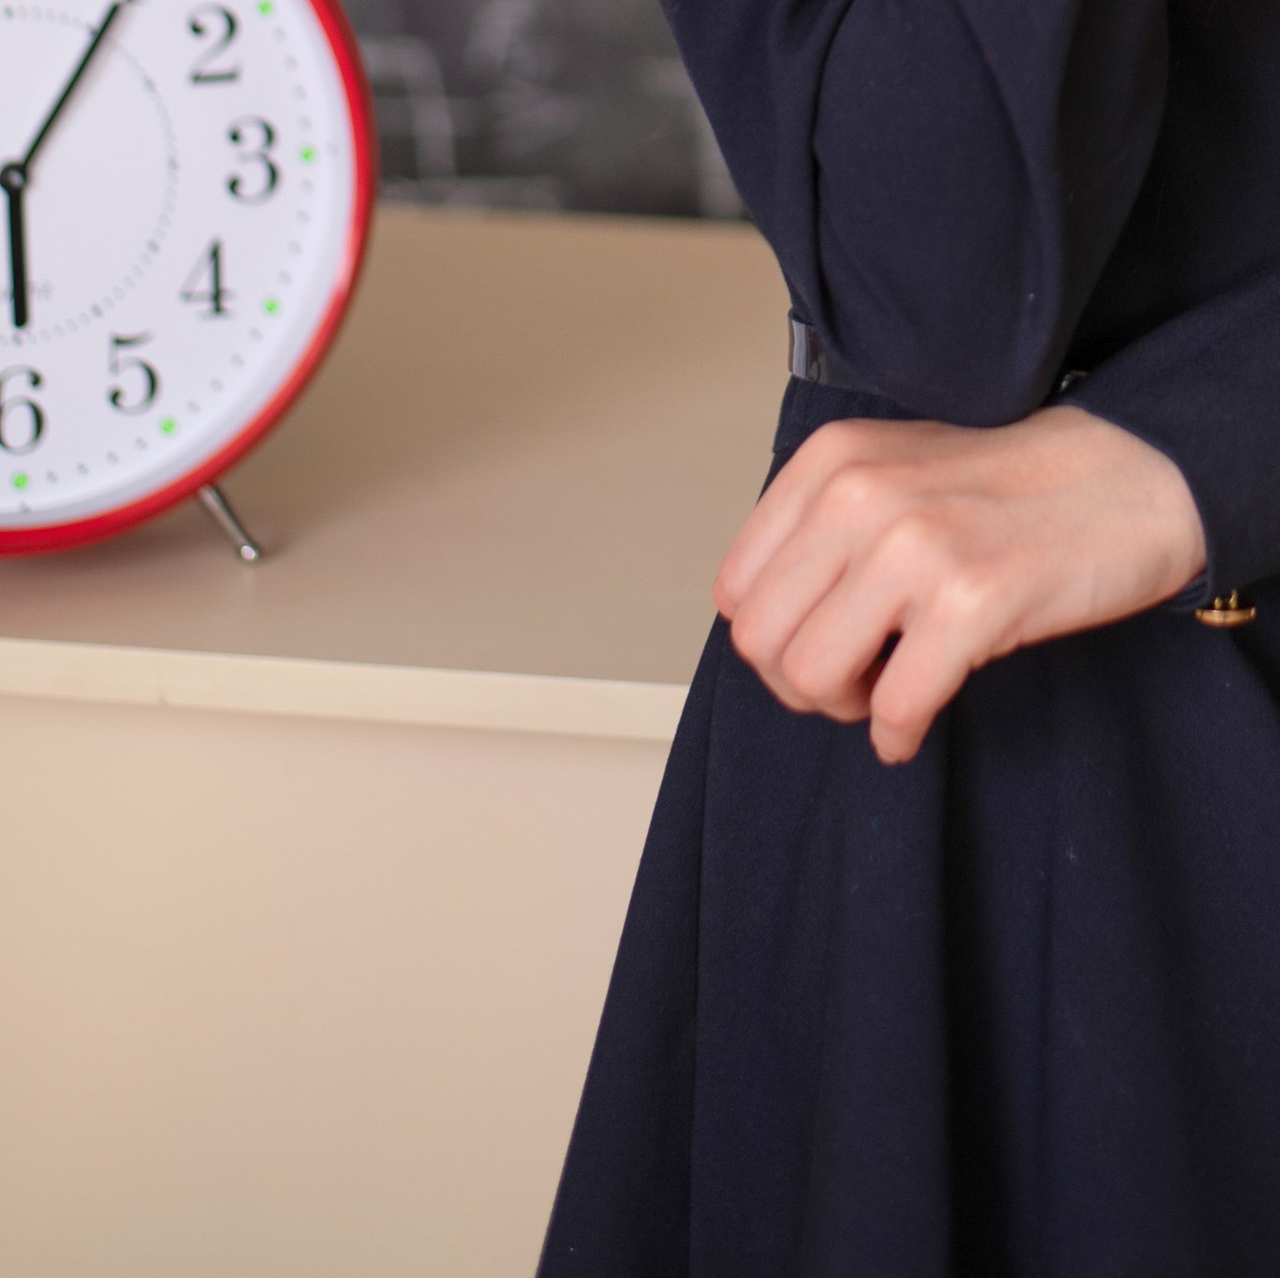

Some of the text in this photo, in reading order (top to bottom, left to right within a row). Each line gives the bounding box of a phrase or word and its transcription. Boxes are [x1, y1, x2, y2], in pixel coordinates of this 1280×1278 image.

[188, 4, 241, 88] 2
[226, 117, 281, 206] 3
[180, 238, 235, 320] 4
[0, 365, 47, 456] 6
[107, 333, 161, 416] 5
